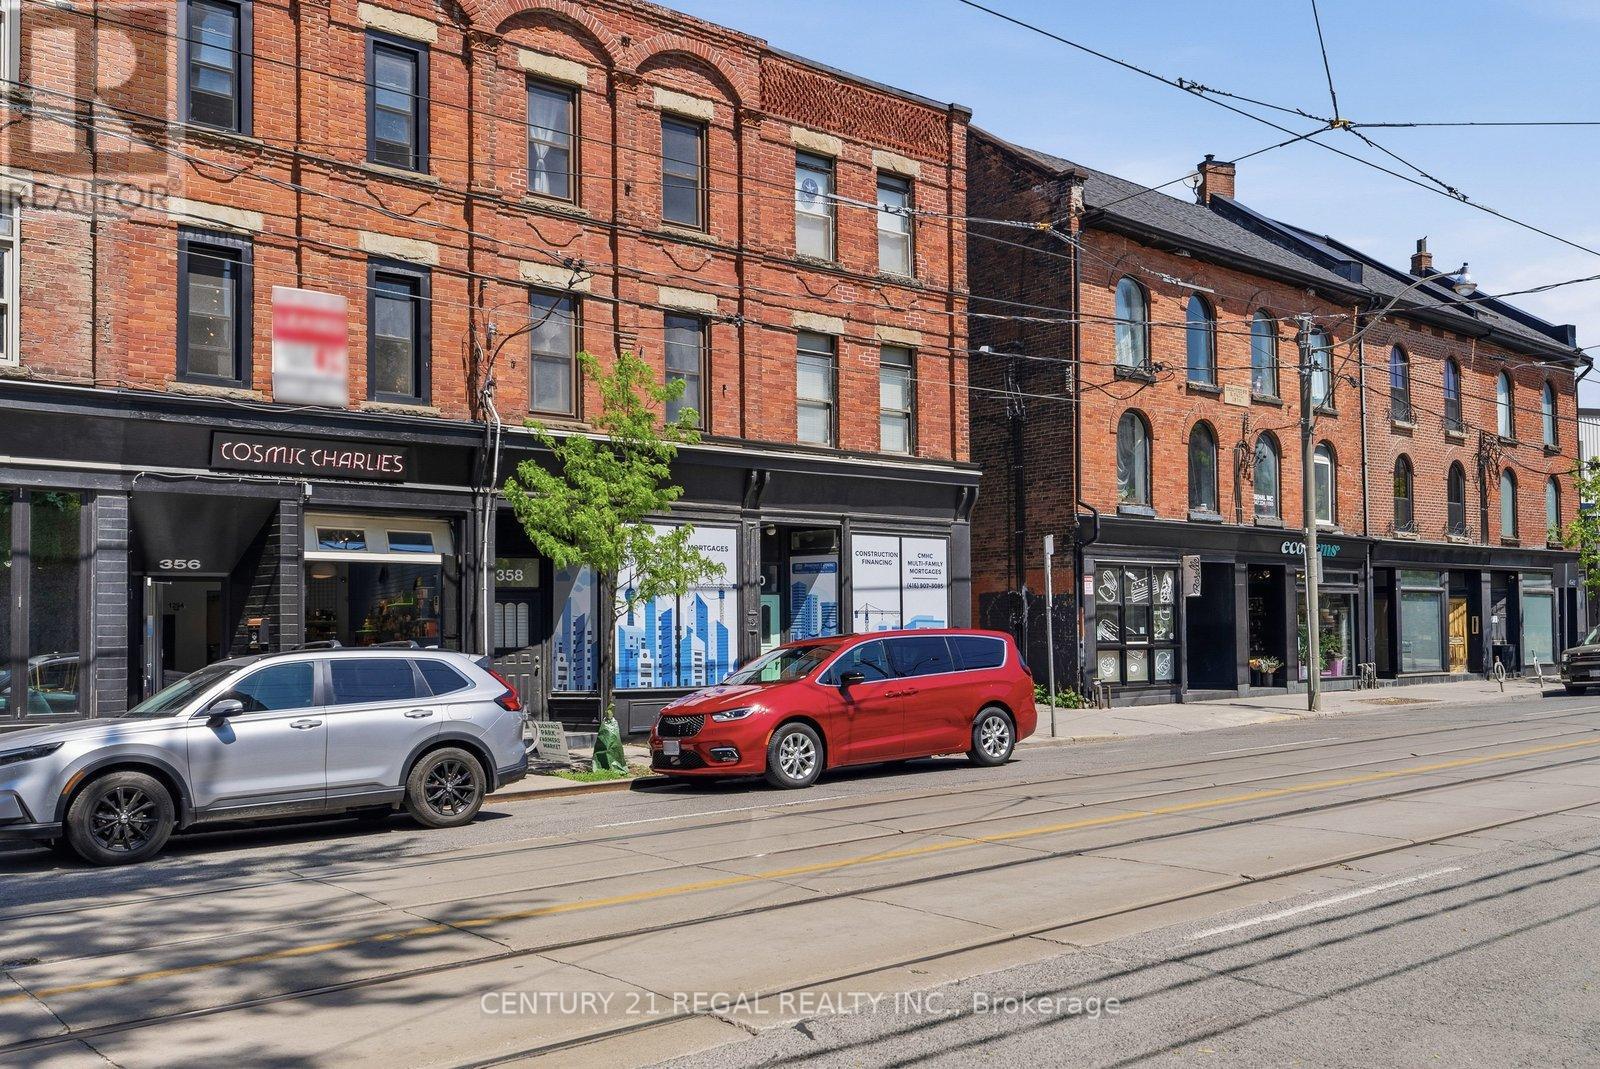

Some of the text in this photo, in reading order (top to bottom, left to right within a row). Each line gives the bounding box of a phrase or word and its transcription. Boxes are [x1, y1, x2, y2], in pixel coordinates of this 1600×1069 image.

[221, 442, 403, 473] COSMIC CHARLIES
[687, 544, 729, 552] MORTGAGES
[1281, 541, 1337, 557] ecoems
[855, 550, 899, 558] CONSTRUCTION
[159, 559, 201, 570] 356
[861, 558, 893, 566] FINANCING
[496, 569, 524, 582] 358
